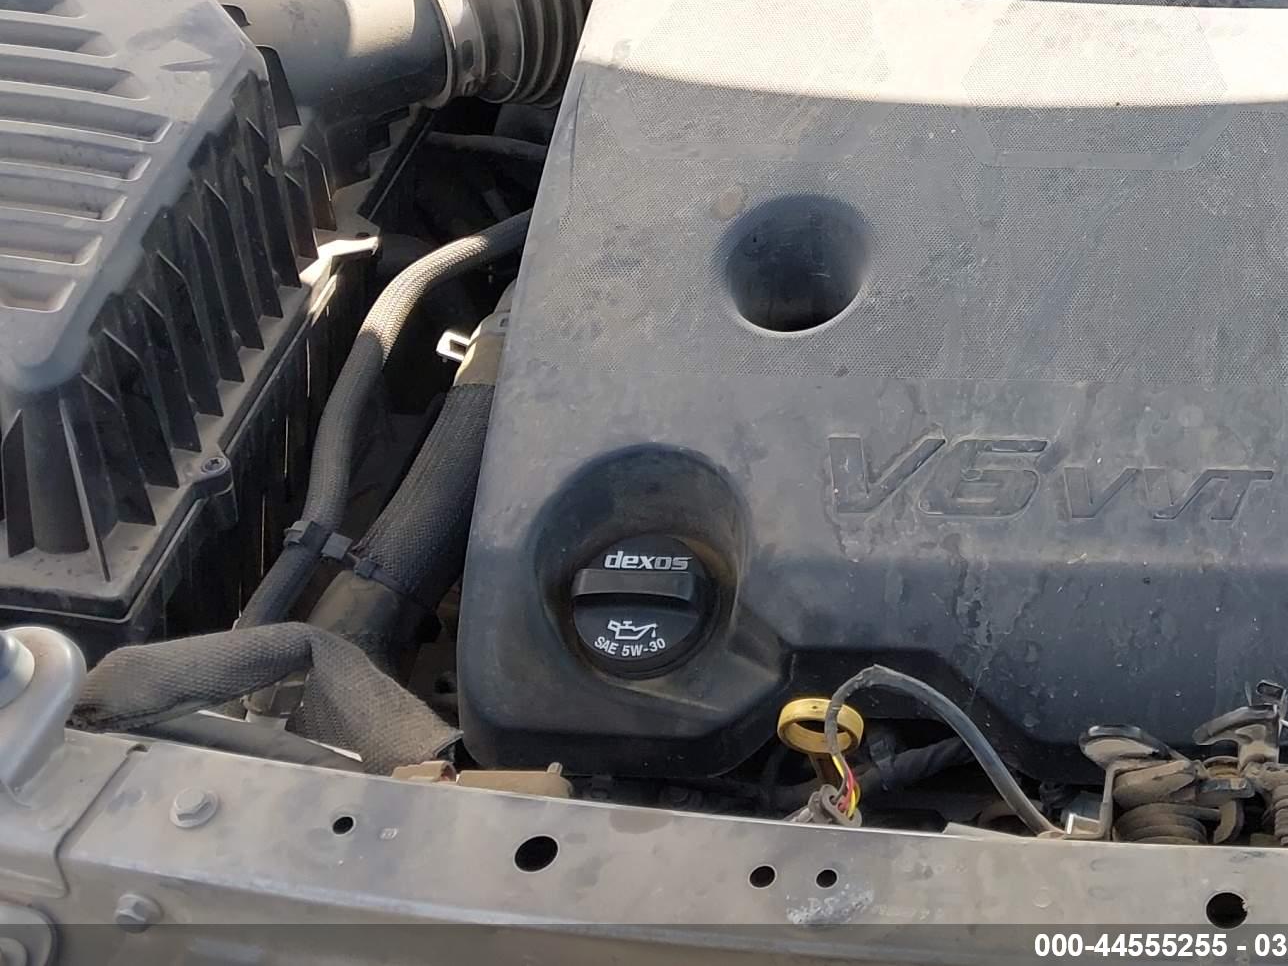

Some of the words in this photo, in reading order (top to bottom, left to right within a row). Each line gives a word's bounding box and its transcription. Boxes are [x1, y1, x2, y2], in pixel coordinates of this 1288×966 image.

[604, 550, 693, 571] dexos
[594, 636, 619, 655] SAE
[621, 638, 666, 657] 5W-30
